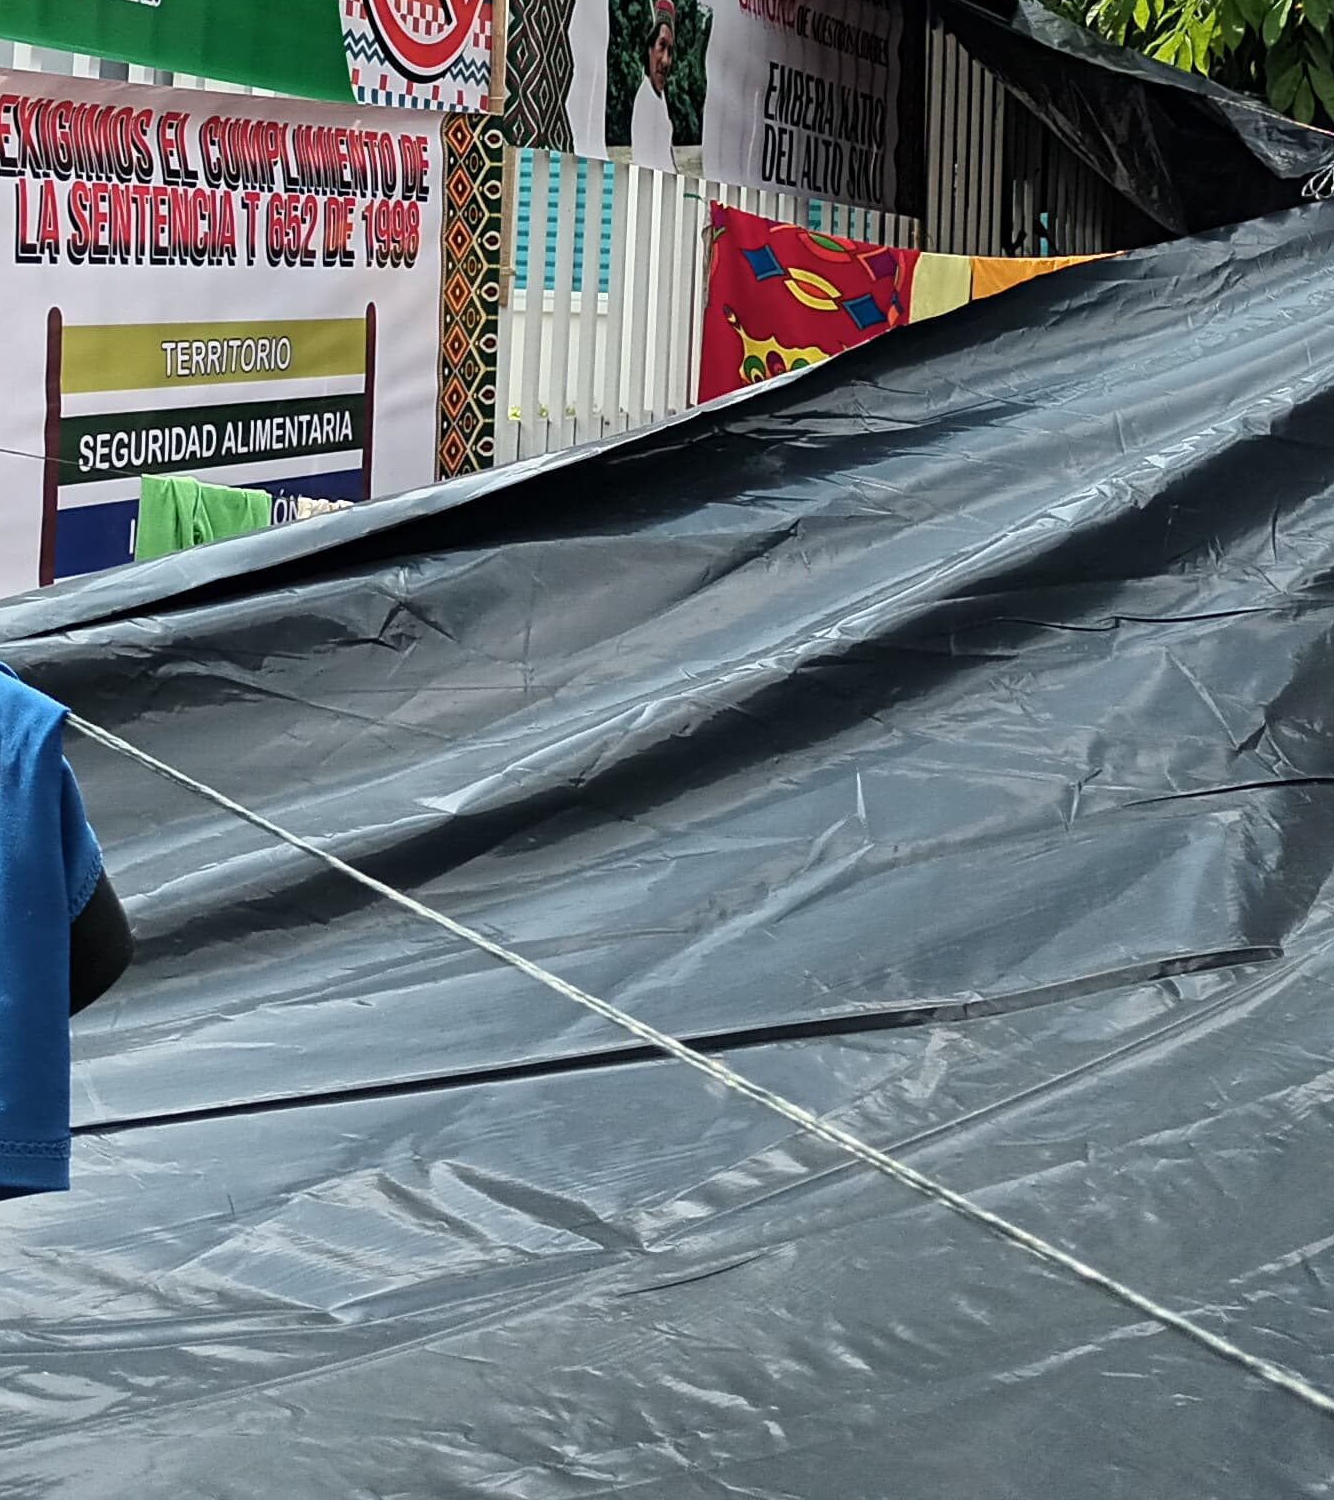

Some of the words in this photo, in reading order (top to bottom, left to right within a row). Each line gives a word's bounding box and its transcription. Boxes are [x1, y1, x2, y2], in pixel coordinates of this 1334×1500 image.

[797, 5, 811, 38] DE
[764, 62, 834, 137] EMBERA
[157, 112, 198, 187] EL
[199, 115, 396, 199] CUMPLIMIENTO
[398, 132, 430, 202] DE
[762, 124, 796, 186] DEL
[802, 136, 843, 196] ALTO
[14, 176, 61, 264] LA
[67, 181, 237, 267] SENTENCIA
[241, 196, 264, 267] T
[266, 197, 318, 267] 652
[323, 198, 356, 267] DE
[361, 198, 420, 269] 1998
[161, 336, 293, 378] TERRITORIO
[77, 419, 218, 473] SEGURIDAD
[222, 410, 353, 455] ALIMENTARIA
